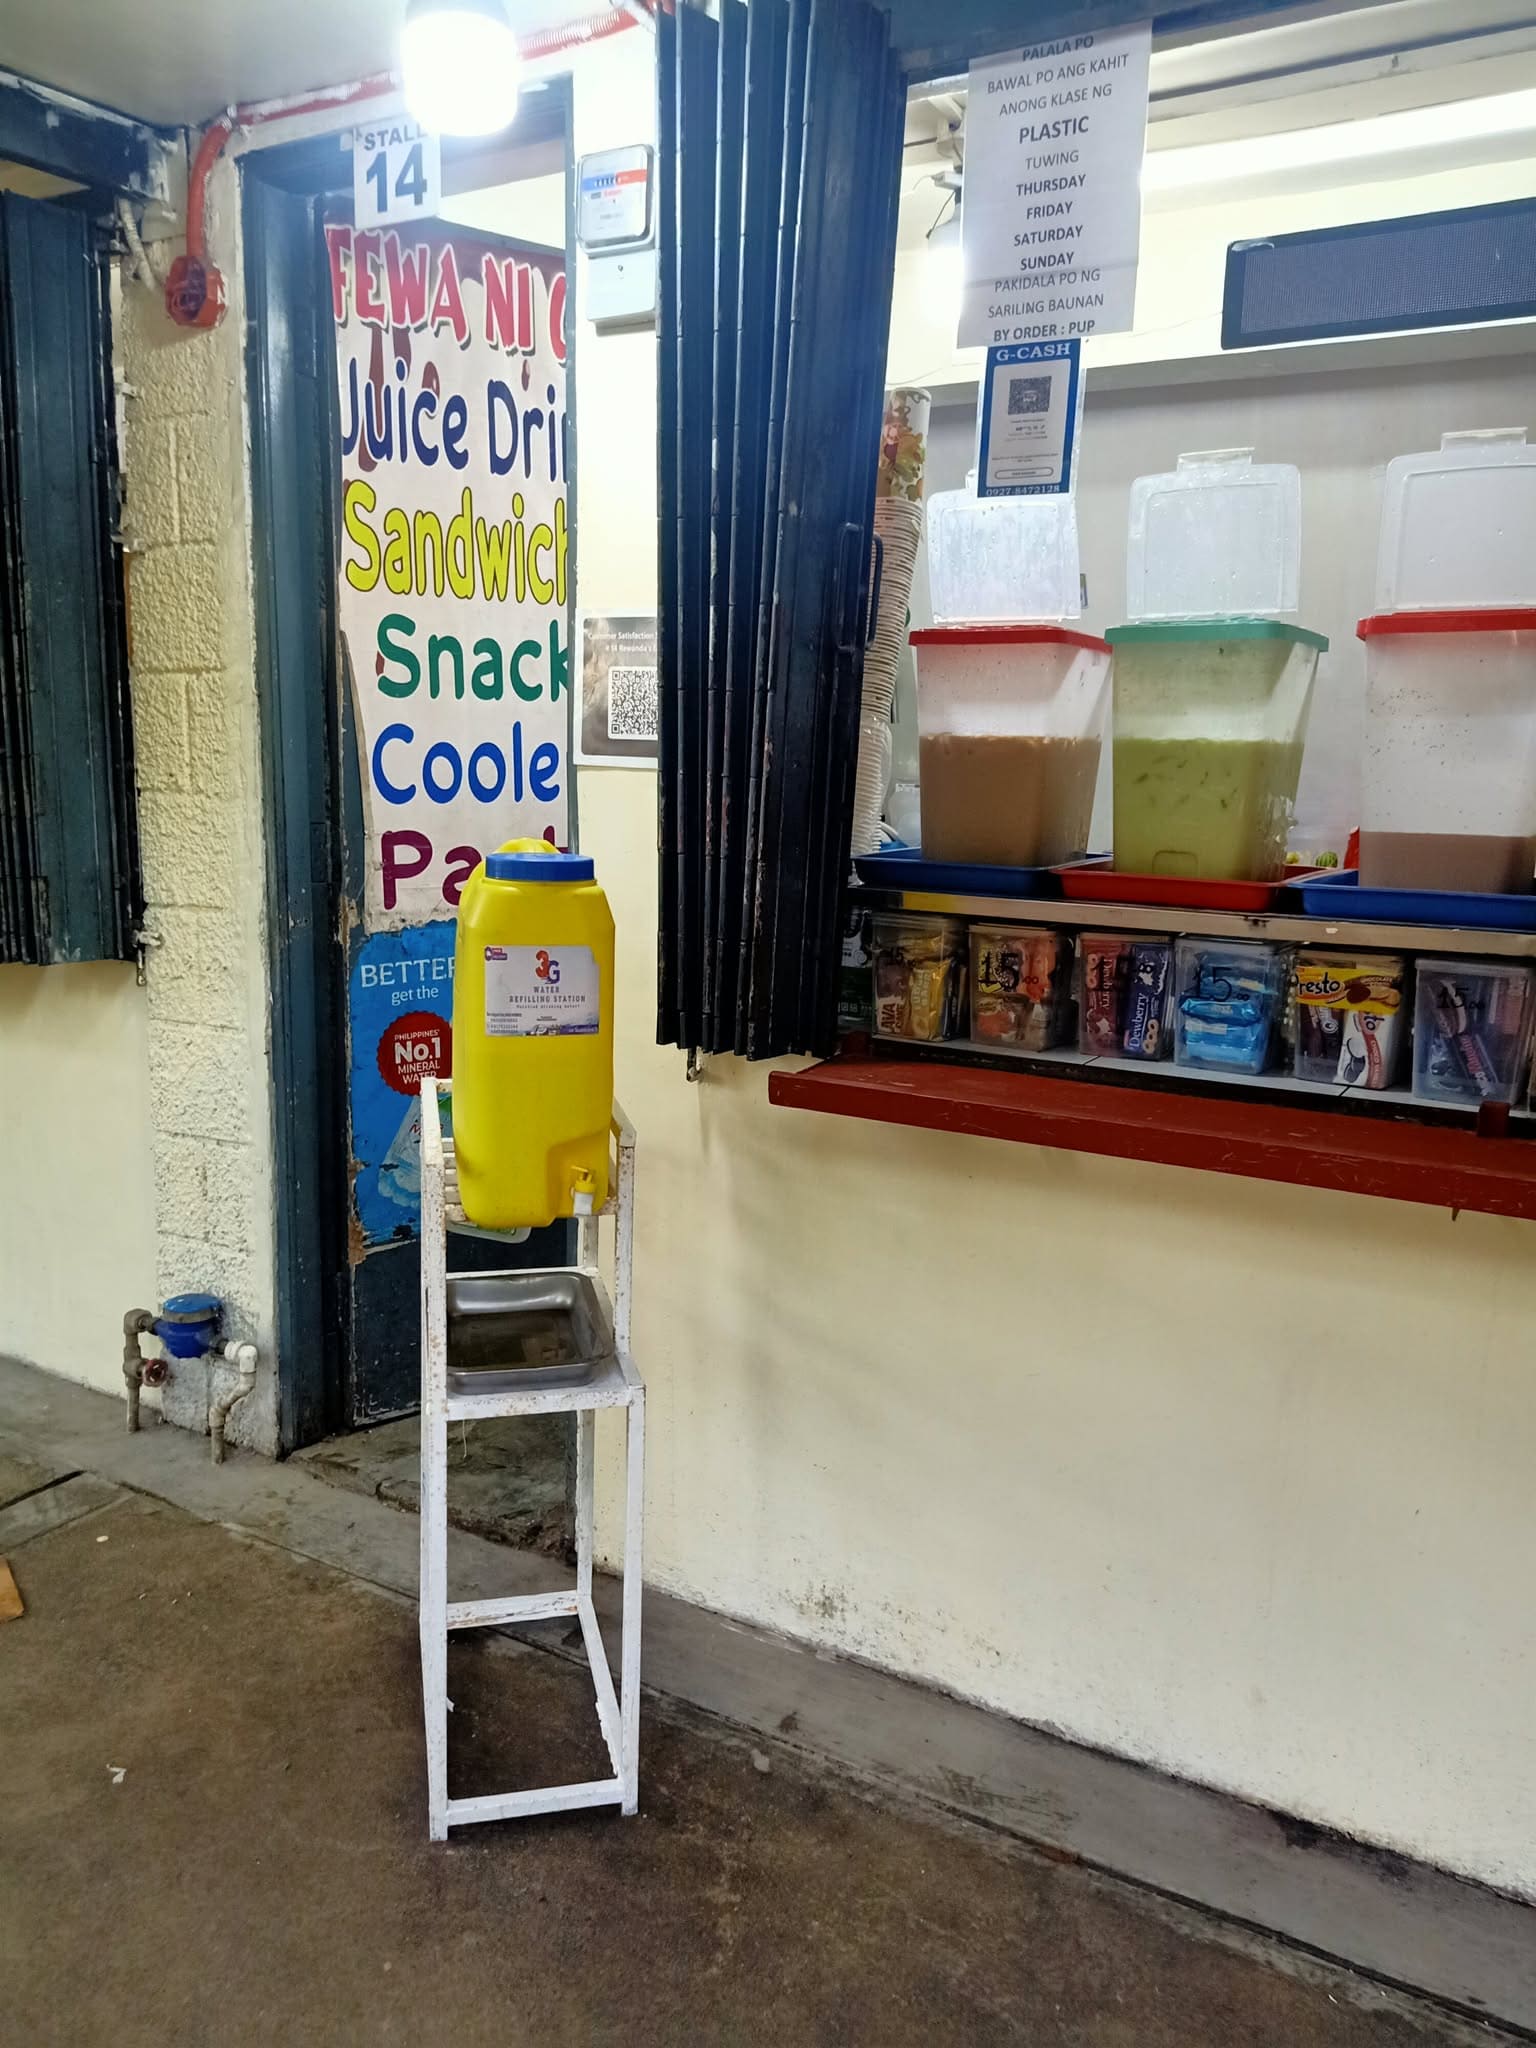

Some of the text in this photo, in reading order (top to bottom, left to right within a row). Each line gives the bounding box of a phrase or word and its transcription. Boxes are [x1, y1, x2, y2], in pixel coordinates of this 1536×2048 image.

[1022, 35, 1094, 62] PALALA PO
[987, 54, 1128, 94] BAWAL PO ANG KAHIT
[999, 83, 1112, 117] ANONG KLASE NG
[364, 122, 429, 151] STALL
[1019, 116, 1089, 144] PLASTIC
[1025, 150, 1079, 170] TUWING
[366, 143, 427, 213] 14
[1016, 174, 1086, 197] THURSDAY
[1026, 202, 1073, 220] FRIDAY
[1014, 225, 1083, 247] SATURDAY
[1020, 252, 1074, 271] SUNDAY
[995, 269, 1100, 293] PAKIDALA PO NG
[484, 255, 532, 349] NI
[988, 294, 1104, 319] SARILING BAUNAN
[993, 327, 1010, 343] BY
[1013, 323, 1059, 341] ORDER
[1068, 320, 1095, 335] PUP
[996, 343, 1071, 361] G-CASH
[342, 357, 469, 470] Juice
[377, 613, 568, 702] Snack
[372, 721, 560, 805] Coole
[536, 950, 561, 985] 3G
[392, 985, 439, 1006] get the
[509, 994, 586, 1003] REFILLING STATION
[533, 986, 560, 994] WATER
[1128, 993, 1149, 1049] Dewberry
[394, 1037, 441, 1064] No.1
[398, 1060, 440, 1075] MINERAL
